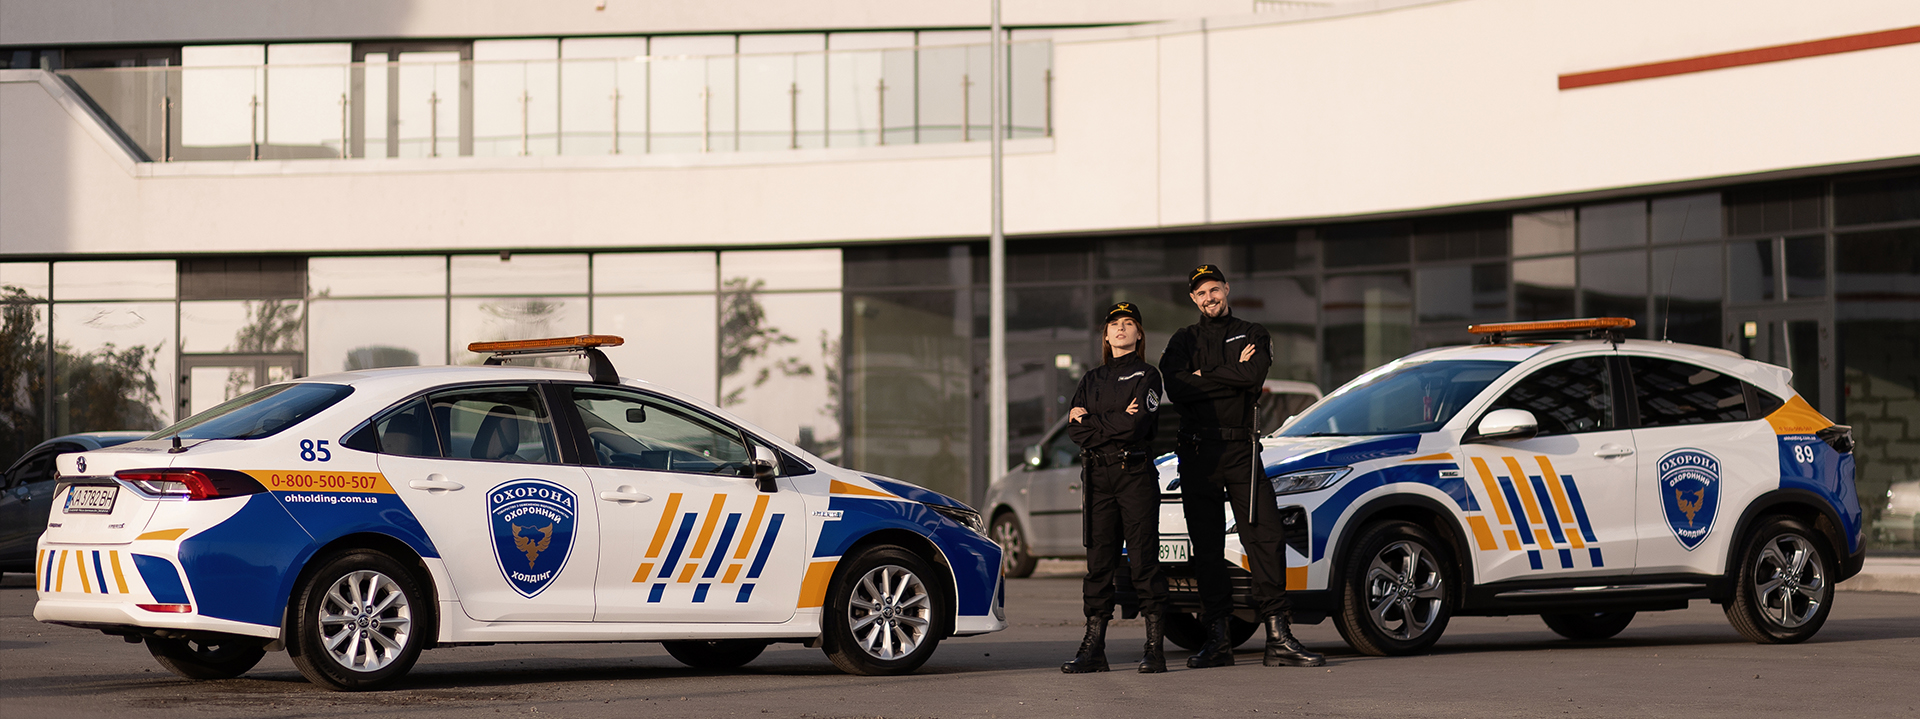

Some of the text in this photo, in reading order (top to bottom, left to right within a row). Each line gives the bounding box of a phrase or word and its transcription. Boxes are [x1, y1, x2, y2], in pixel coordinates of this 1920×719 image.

[299, 438, 332, 462] 85
[1794, 444, 1814, 463] 89
[1661, 454, 1718, 472] ОХОРОНА
[271, 473, 377, 489] 0-800-500-507
[284, 493, 378, 505] ohholding.com.ua
[493, 486, 573, 508] ОХОРОНА
[504, 506, 562, 524] ОХОРОННИЙ
[1172, 544, 1187, 560] YA
[511, 570, 552, 583] ХОЛДІНГ
